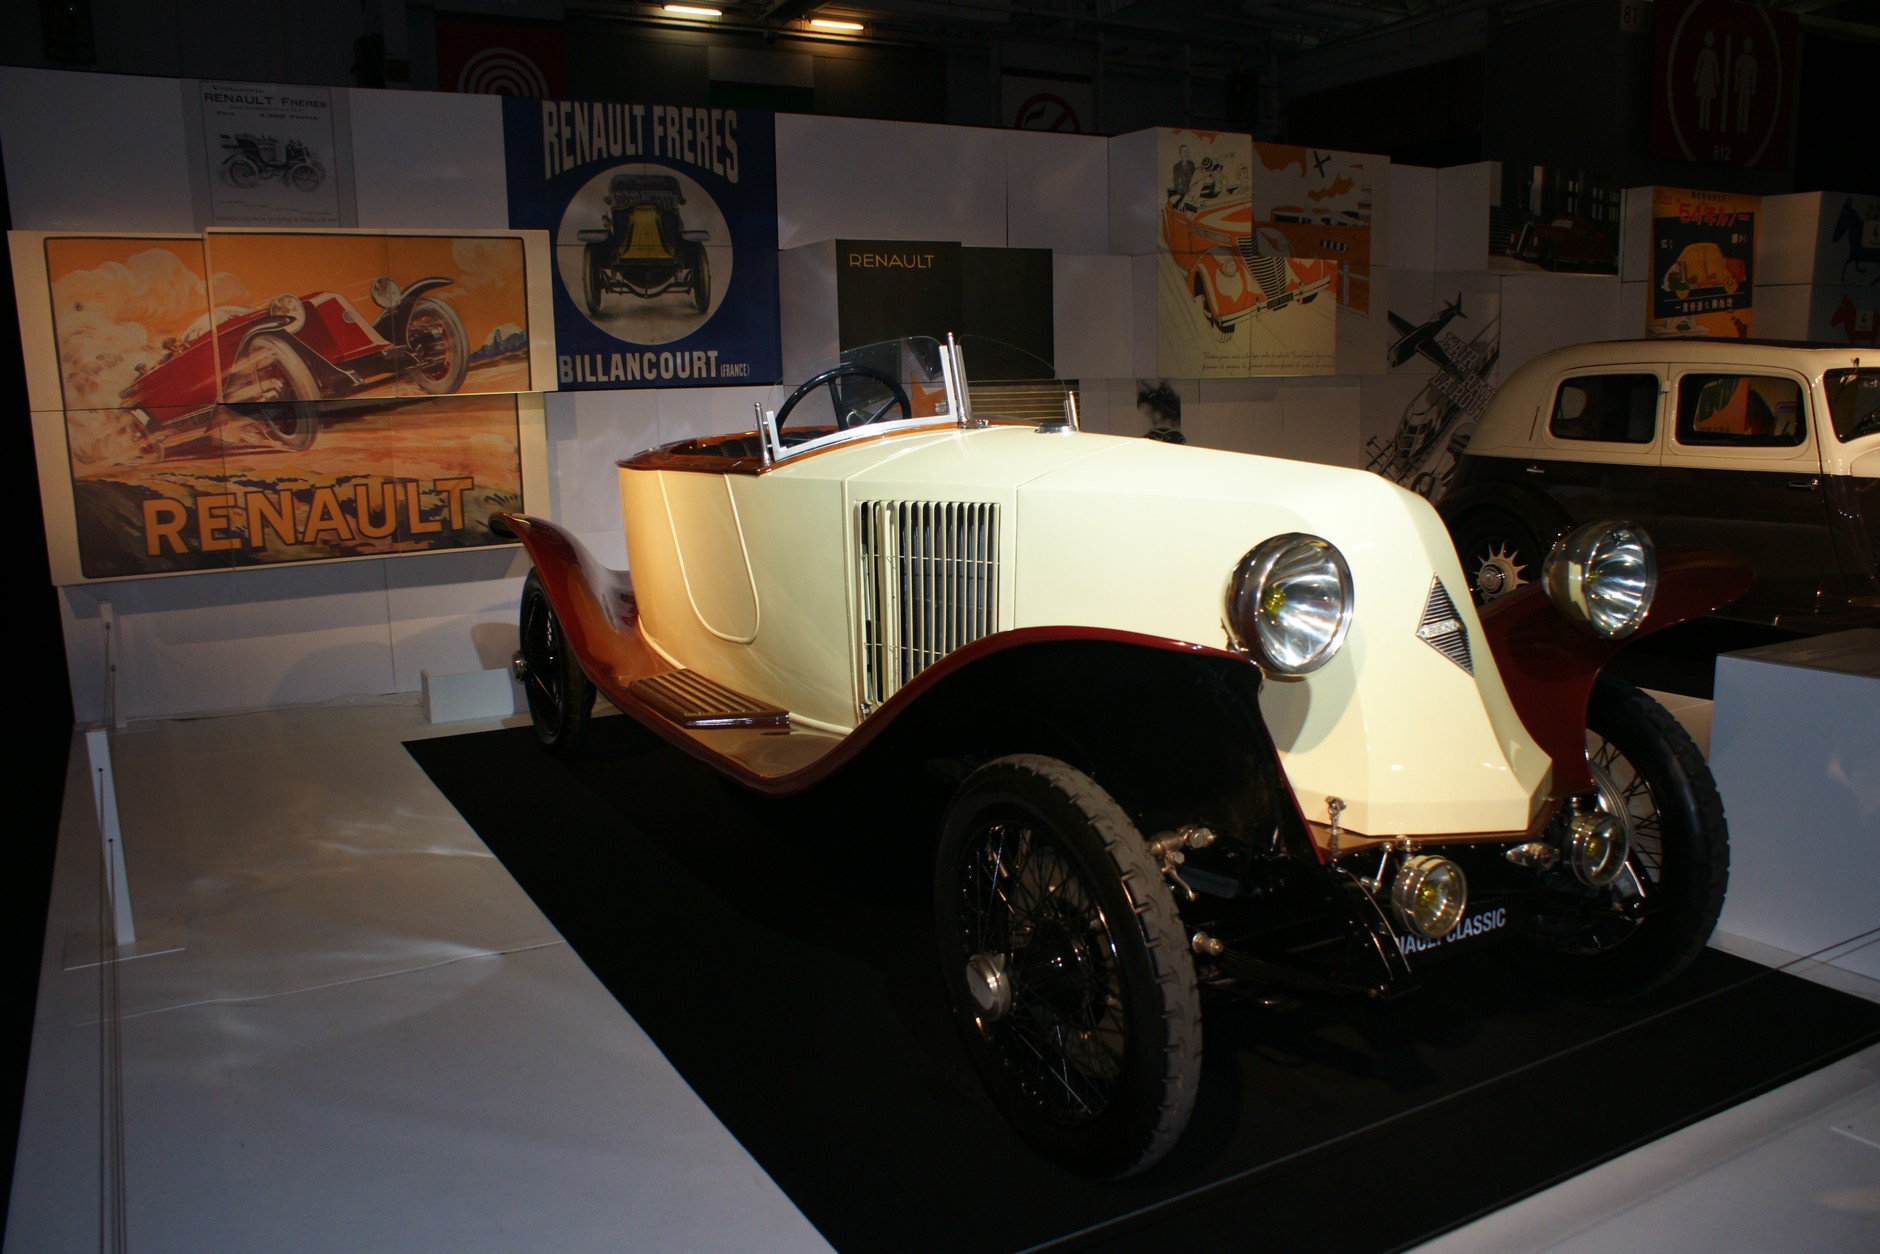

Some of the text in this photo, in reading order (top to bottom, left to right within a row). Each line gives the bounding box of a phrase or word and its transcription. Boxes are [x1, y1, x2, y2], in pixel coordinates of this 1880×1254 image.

[204, 92, 273, 106] RENAULT
[541, 100, 740, 184] RENAULT FRERES
[1713, 144, 1732, 161] 812
[848, 252, 936, 269] RENAULT
[558, 350, 750, 384] BILLANCOURT (FRANCE)
[143, 476, 474, 556] RENAULT
